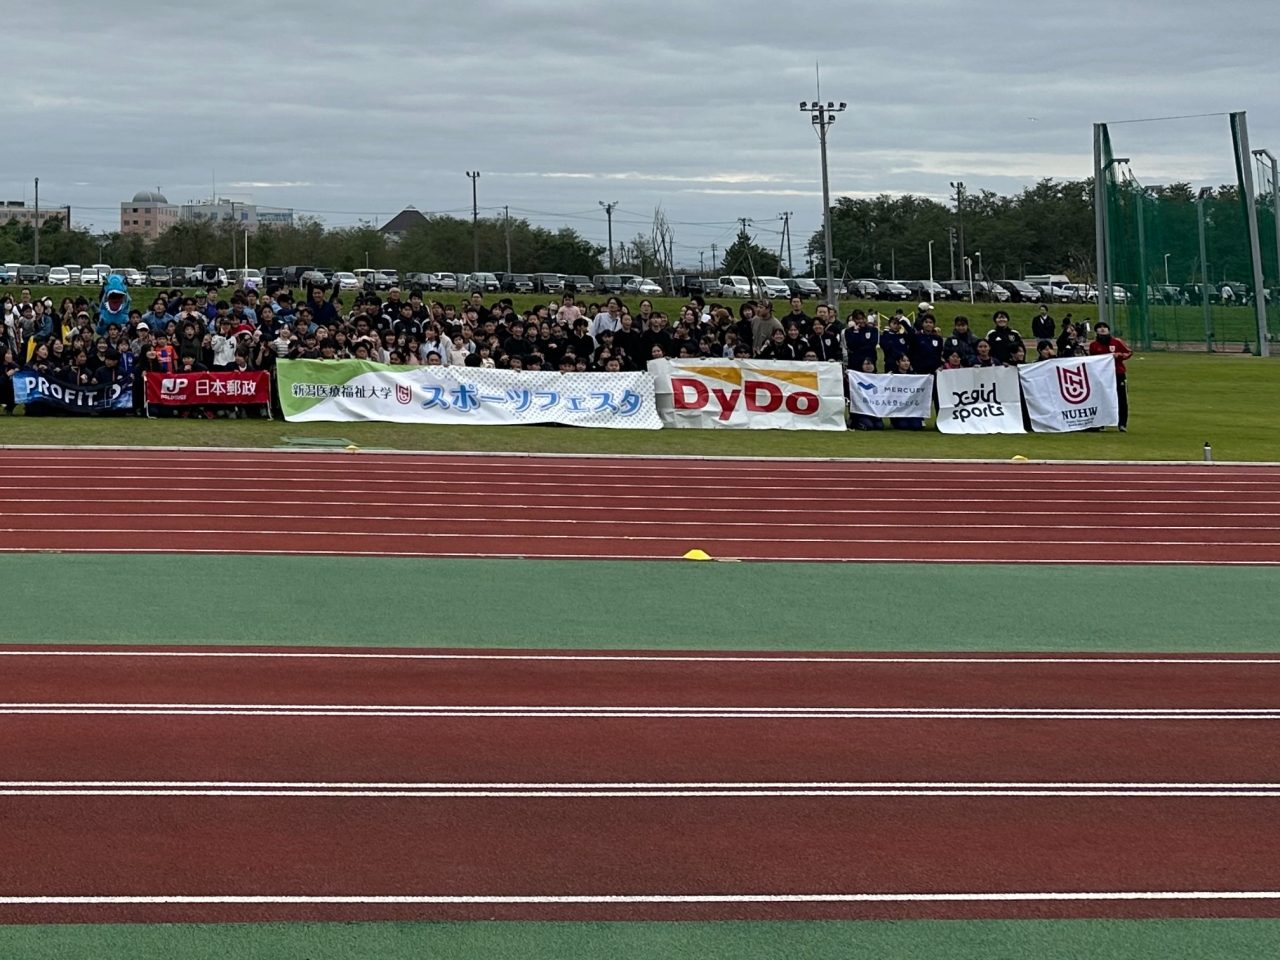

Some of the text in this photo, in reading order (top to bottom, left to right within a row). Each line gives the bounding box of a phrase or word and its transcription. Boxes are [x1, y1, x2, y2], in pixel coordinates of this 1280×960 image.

[195, 379, 257, 396] 日本郵政
[292, 383, 392, 399] 新潟医療福祉大学
[421, 383, 643, 416] スポーツフェスタ
[671, 378, 820, 421] DyDo
[952, 404, 1004, 422] sports
[1061, 406, 1098, 420] NUHW
